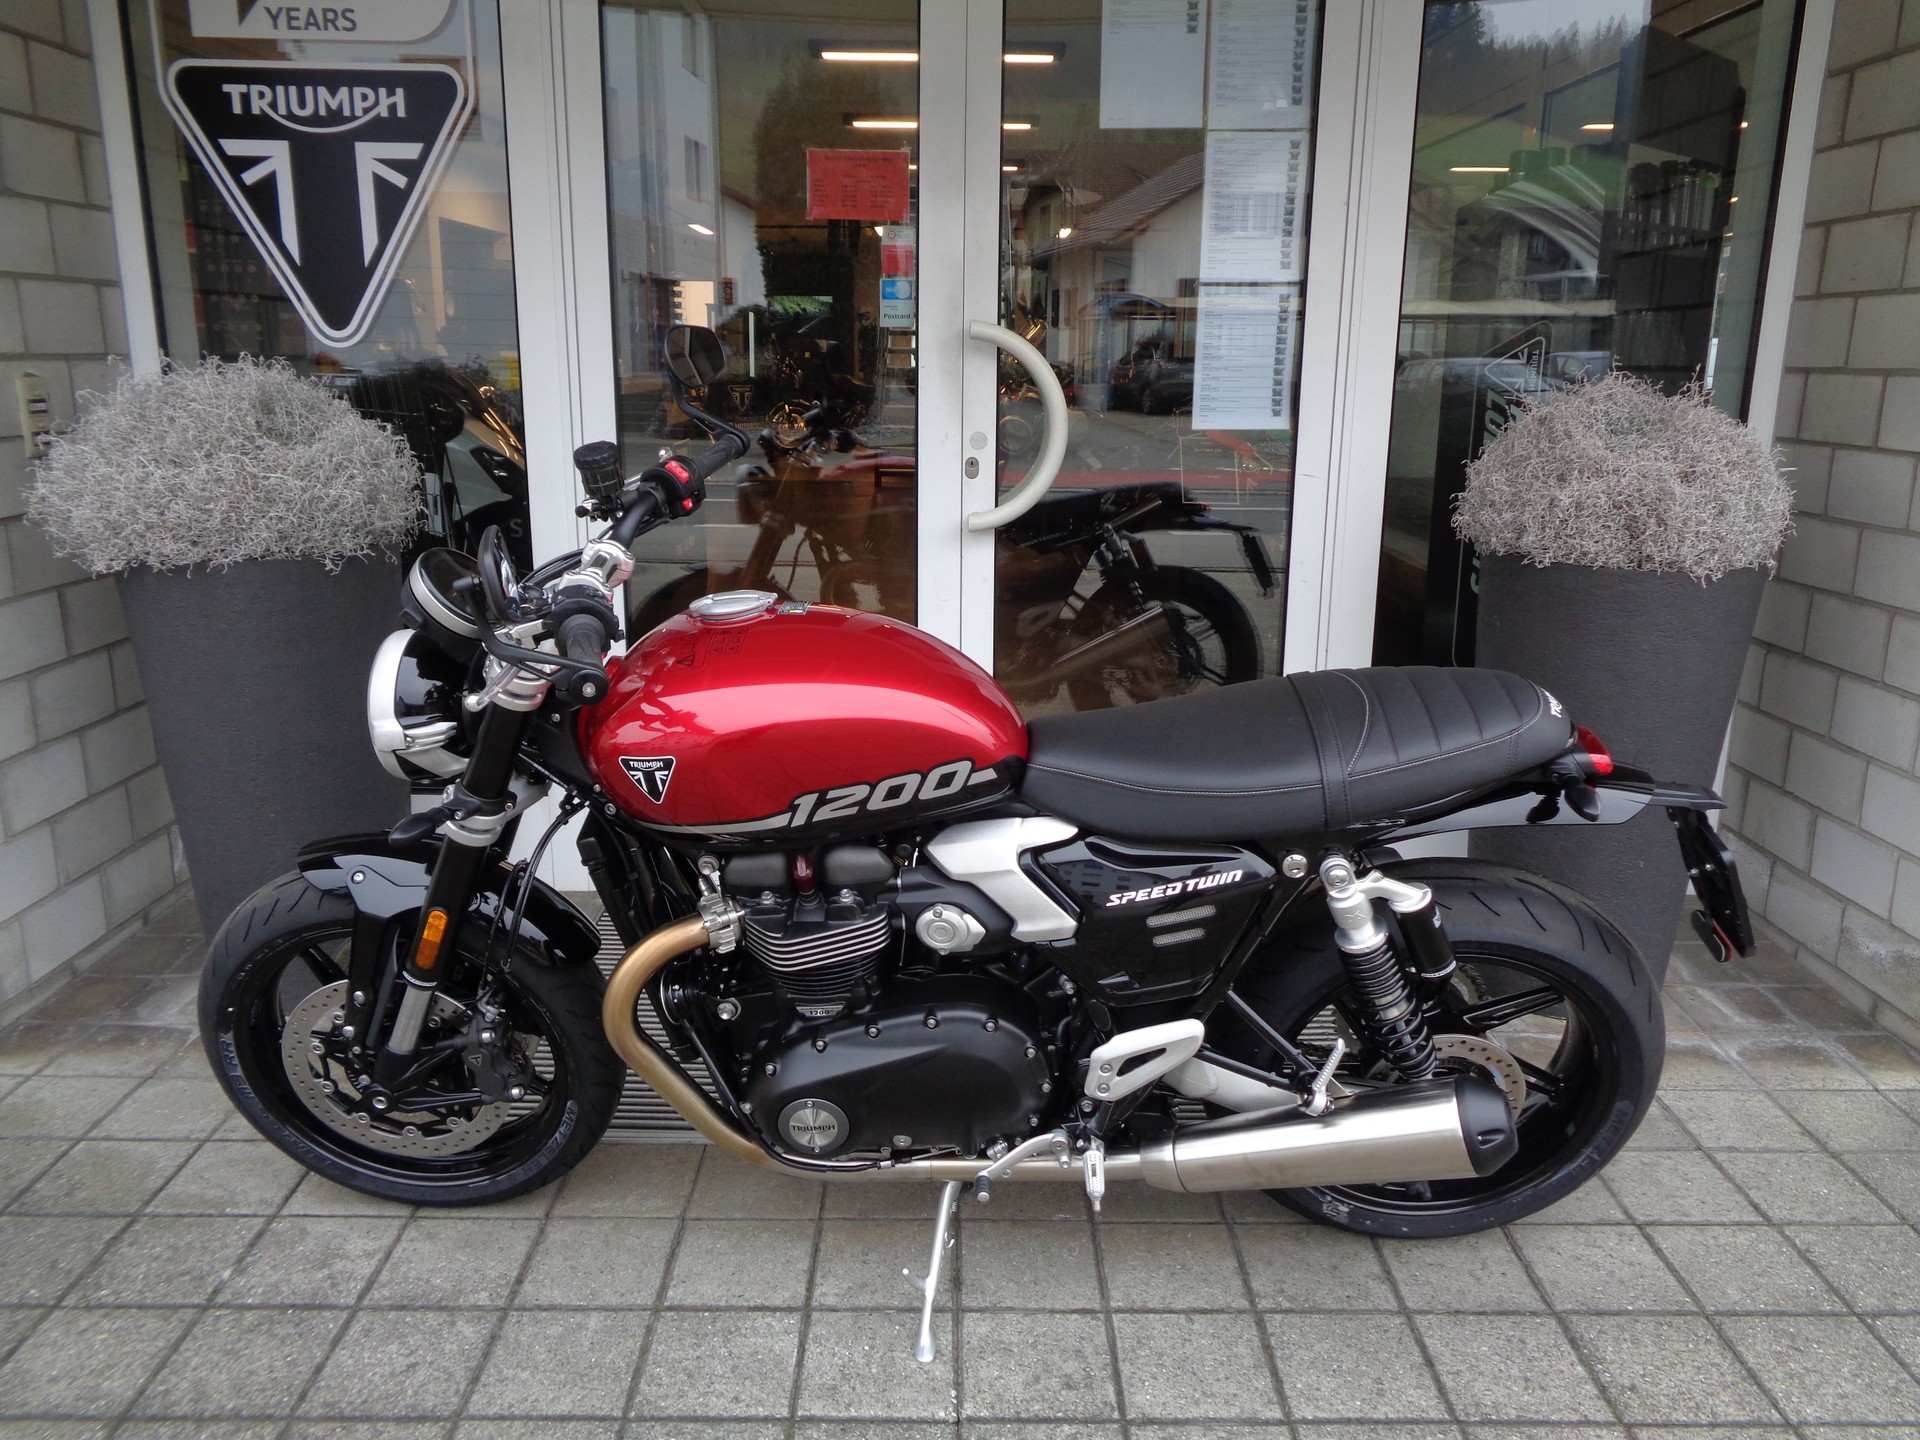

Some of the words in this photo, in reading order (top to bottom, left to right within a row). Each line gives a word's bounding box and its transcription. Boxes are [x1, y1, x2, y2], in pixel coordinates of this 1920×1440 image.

[264, 6, 357, 32] YEARS
[221, 83, 406, 134] TRIUMPH
[883, 312, 911, 320] Postcard
[1526, 349, 1540, 391] TRIUMPH
[628, 761, 664, 771] TRIUMPH
[790, 760, 973, 828] 1200
[1105, 882, 1183, 907] SPEED
[1186, 869, 1243, 892] TWIN
[792, 1124, 835, 1134] TRIUMPH
